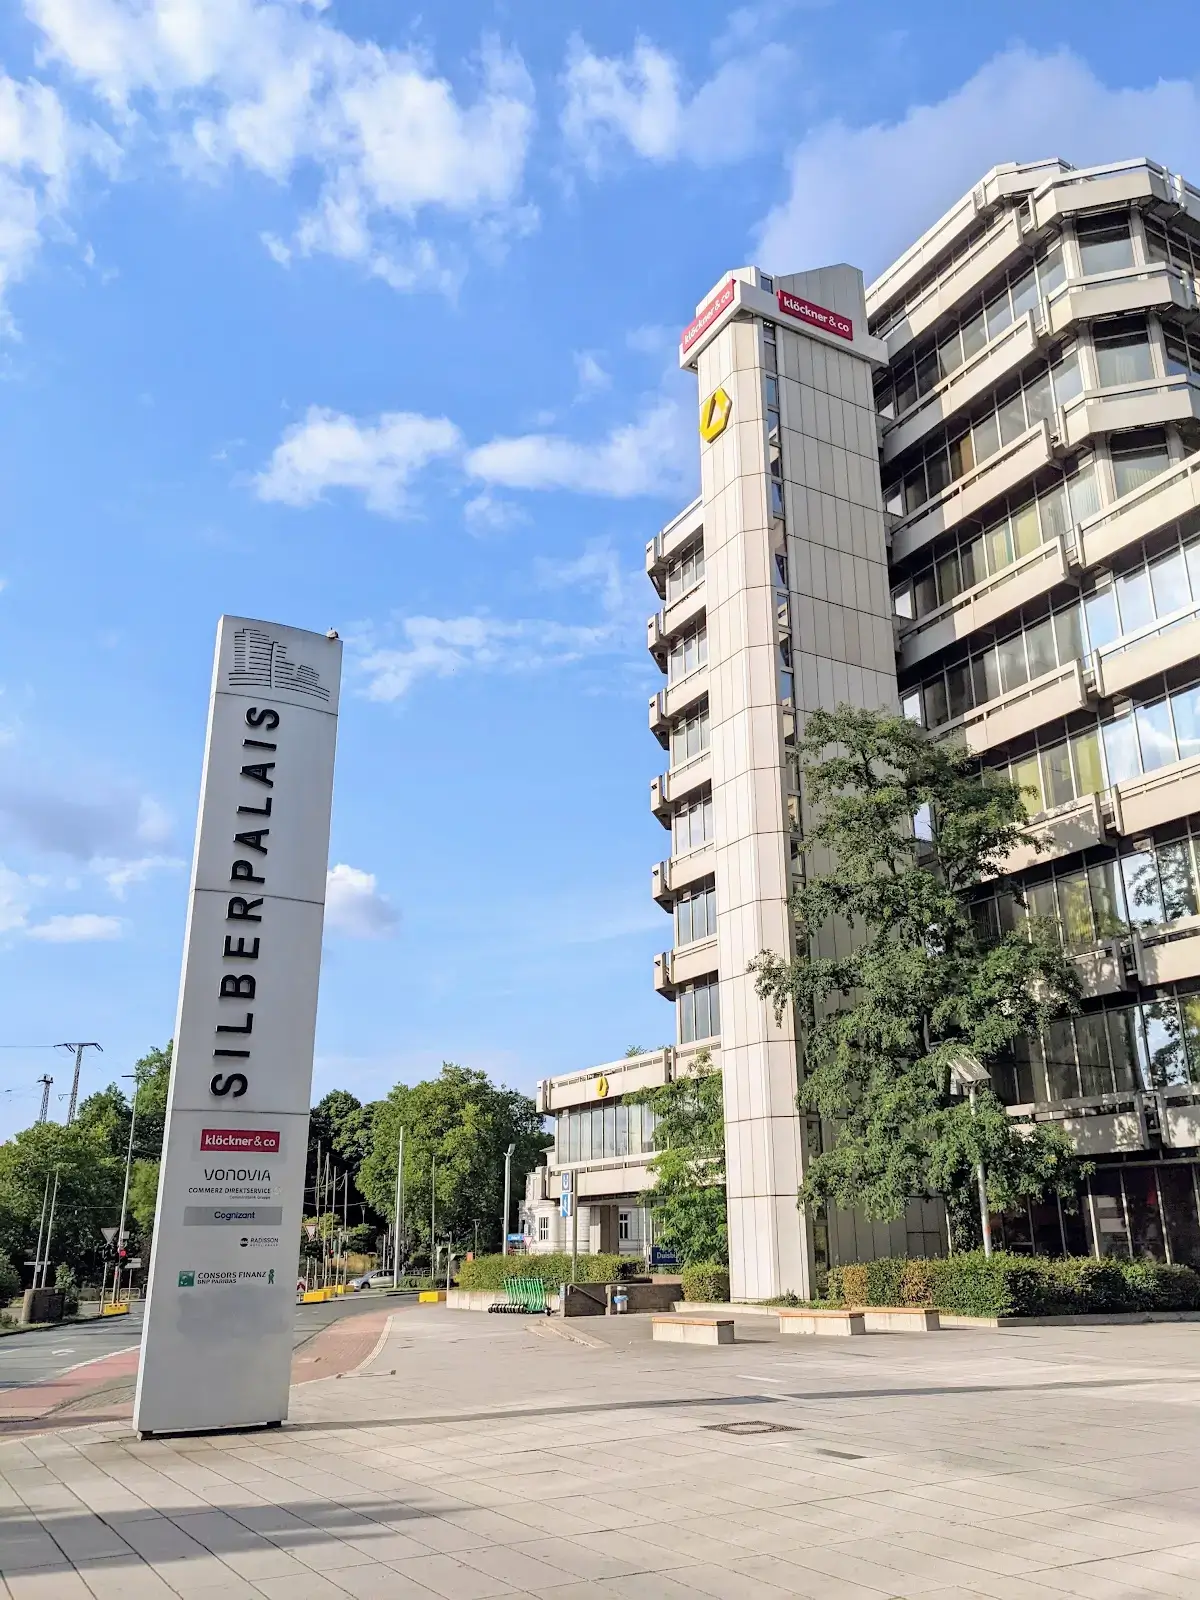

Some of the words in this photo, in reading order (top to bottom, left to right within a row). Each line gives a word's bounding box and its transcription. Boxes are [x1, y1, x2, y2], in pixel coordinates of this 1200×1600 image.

[783, 296, 828, 323] klöckner
[837, 322, 850, 333] co
[211, 706, 280, 1098] SILBERPALAIS
[205, 1134, 253, 1146] klöckner
[263, 1139, 276, 1147] co
[214, 1211, 256, 1221] Cognizant
